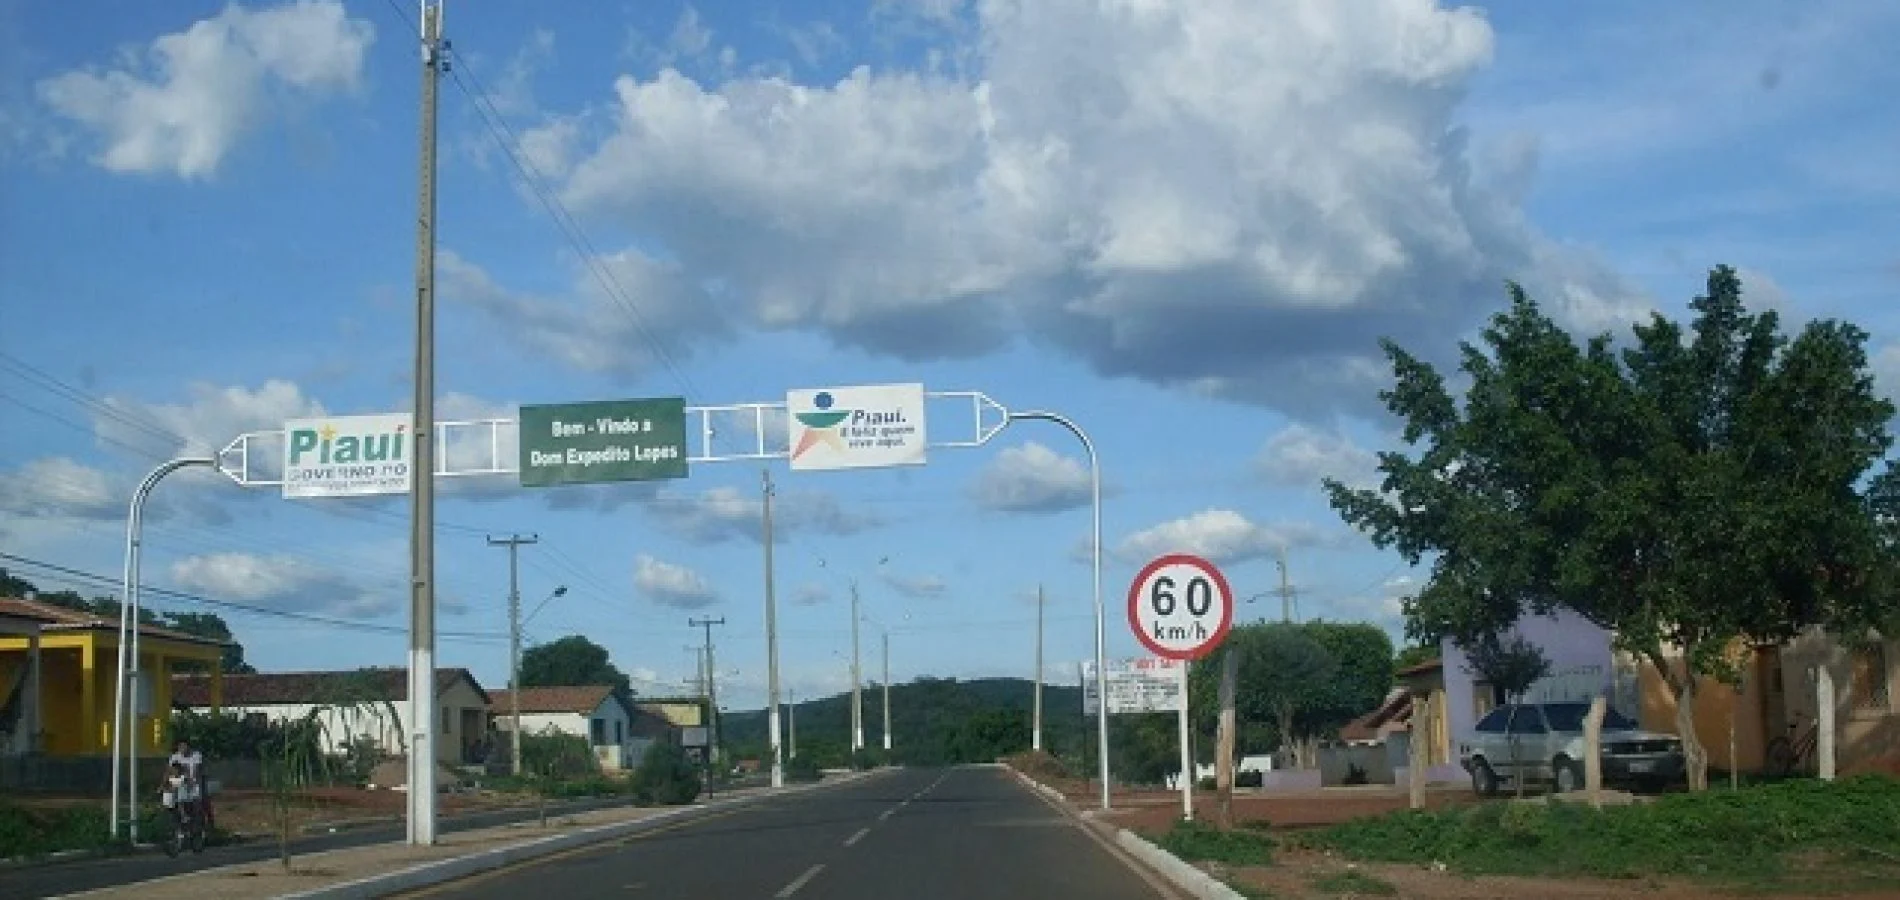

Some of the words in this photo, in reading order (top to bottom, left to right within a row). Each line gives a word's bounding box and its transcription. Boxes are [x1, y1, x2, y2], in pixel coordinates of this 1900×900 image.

[551, 420, 585, 437] Bem
[596, 416, 638, 434] Vindo
[641, 419, 652, 432] a
[290, 423, 406, 465] Piauí
[530, 450, 563, 467] Dom
[566, 446, 630, 467] Expedito
[634, 445, 678, 464] Lopes
[1151, 575, 1212, 617] 60
[1154, 621, 1206, 640] km/h
